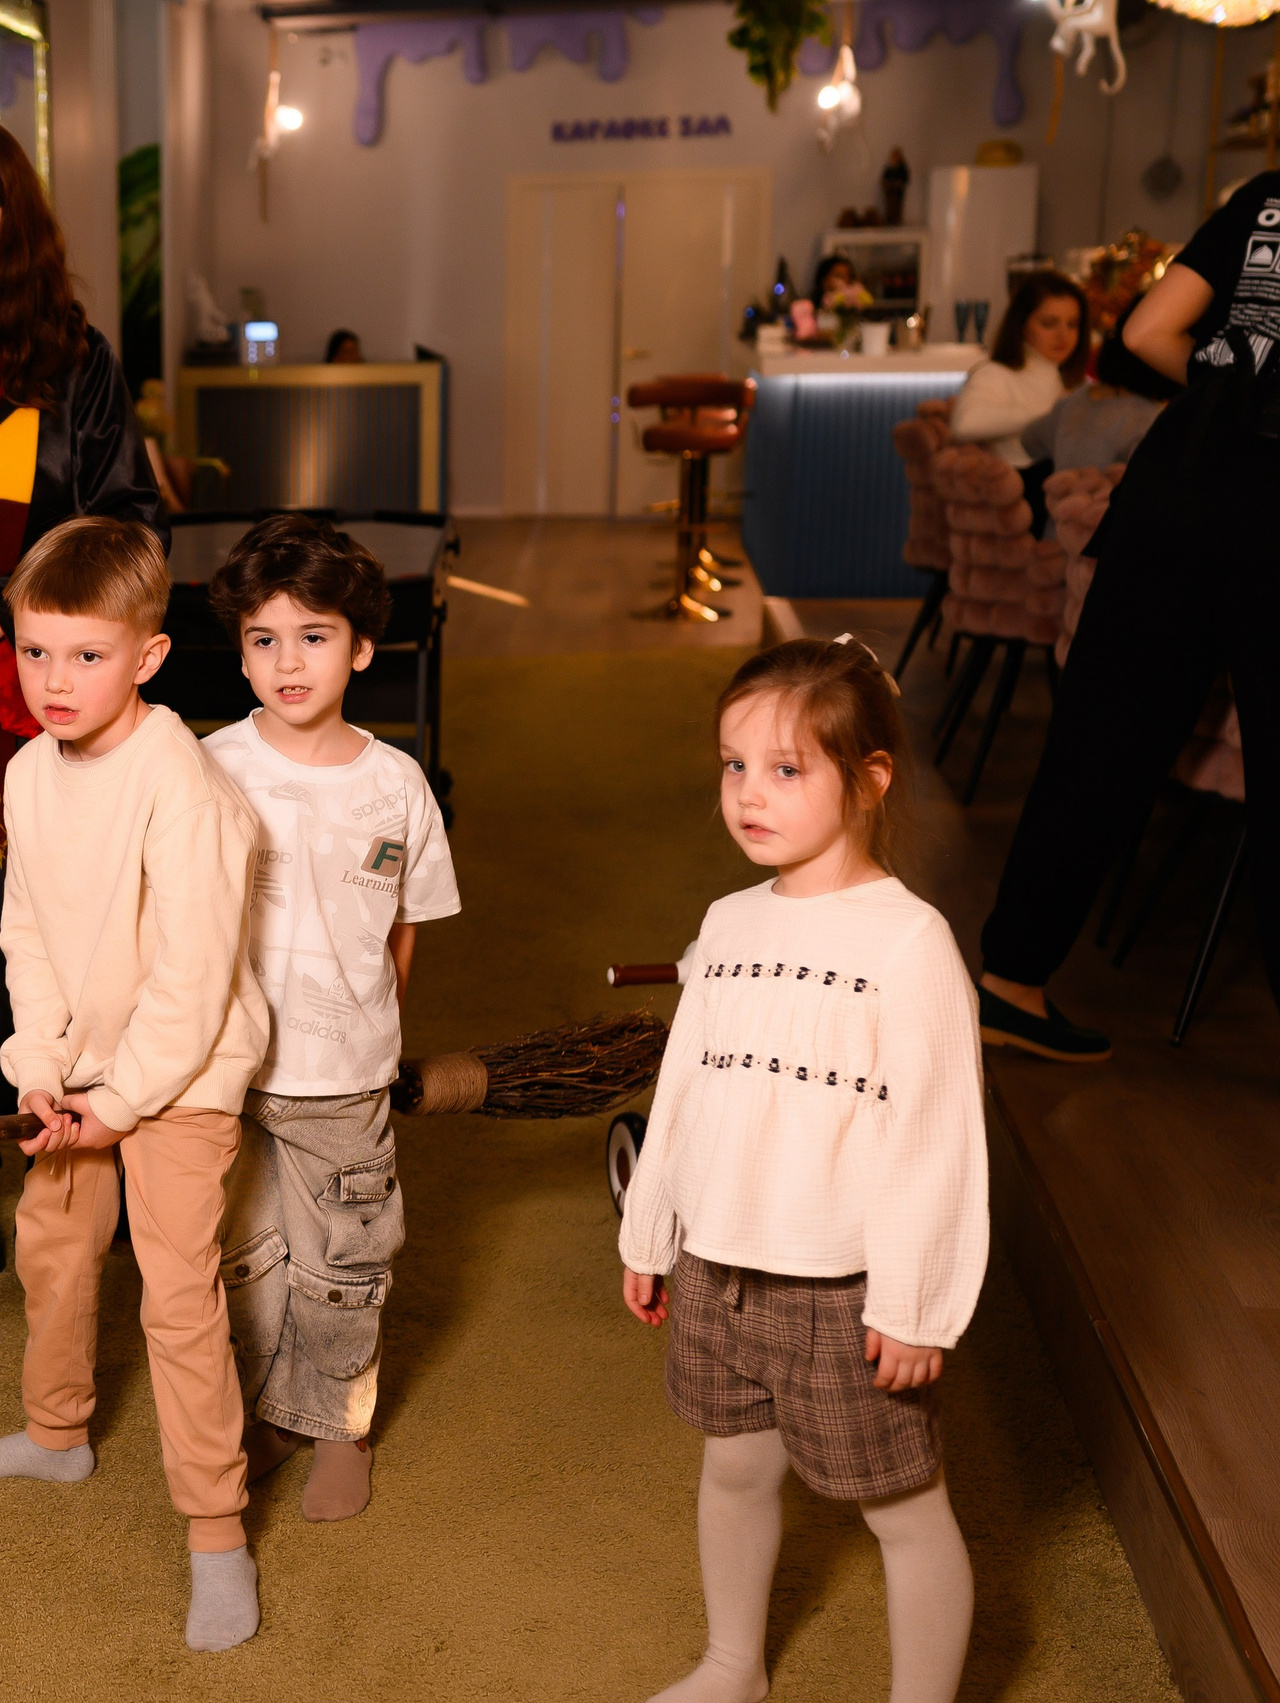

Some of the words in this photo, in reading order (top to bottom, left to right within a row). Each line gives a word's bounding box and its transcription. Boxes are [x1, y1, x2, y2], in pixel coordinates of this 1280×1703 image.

[551, 118, 669, 142] КАРАОКЕ
[679, 114, 732, 138] ЗАЛ
[370, 841, 404, 871] F
[340, 870, 400, 899] Learning
[287, 1017, 347, 1044] adidas
